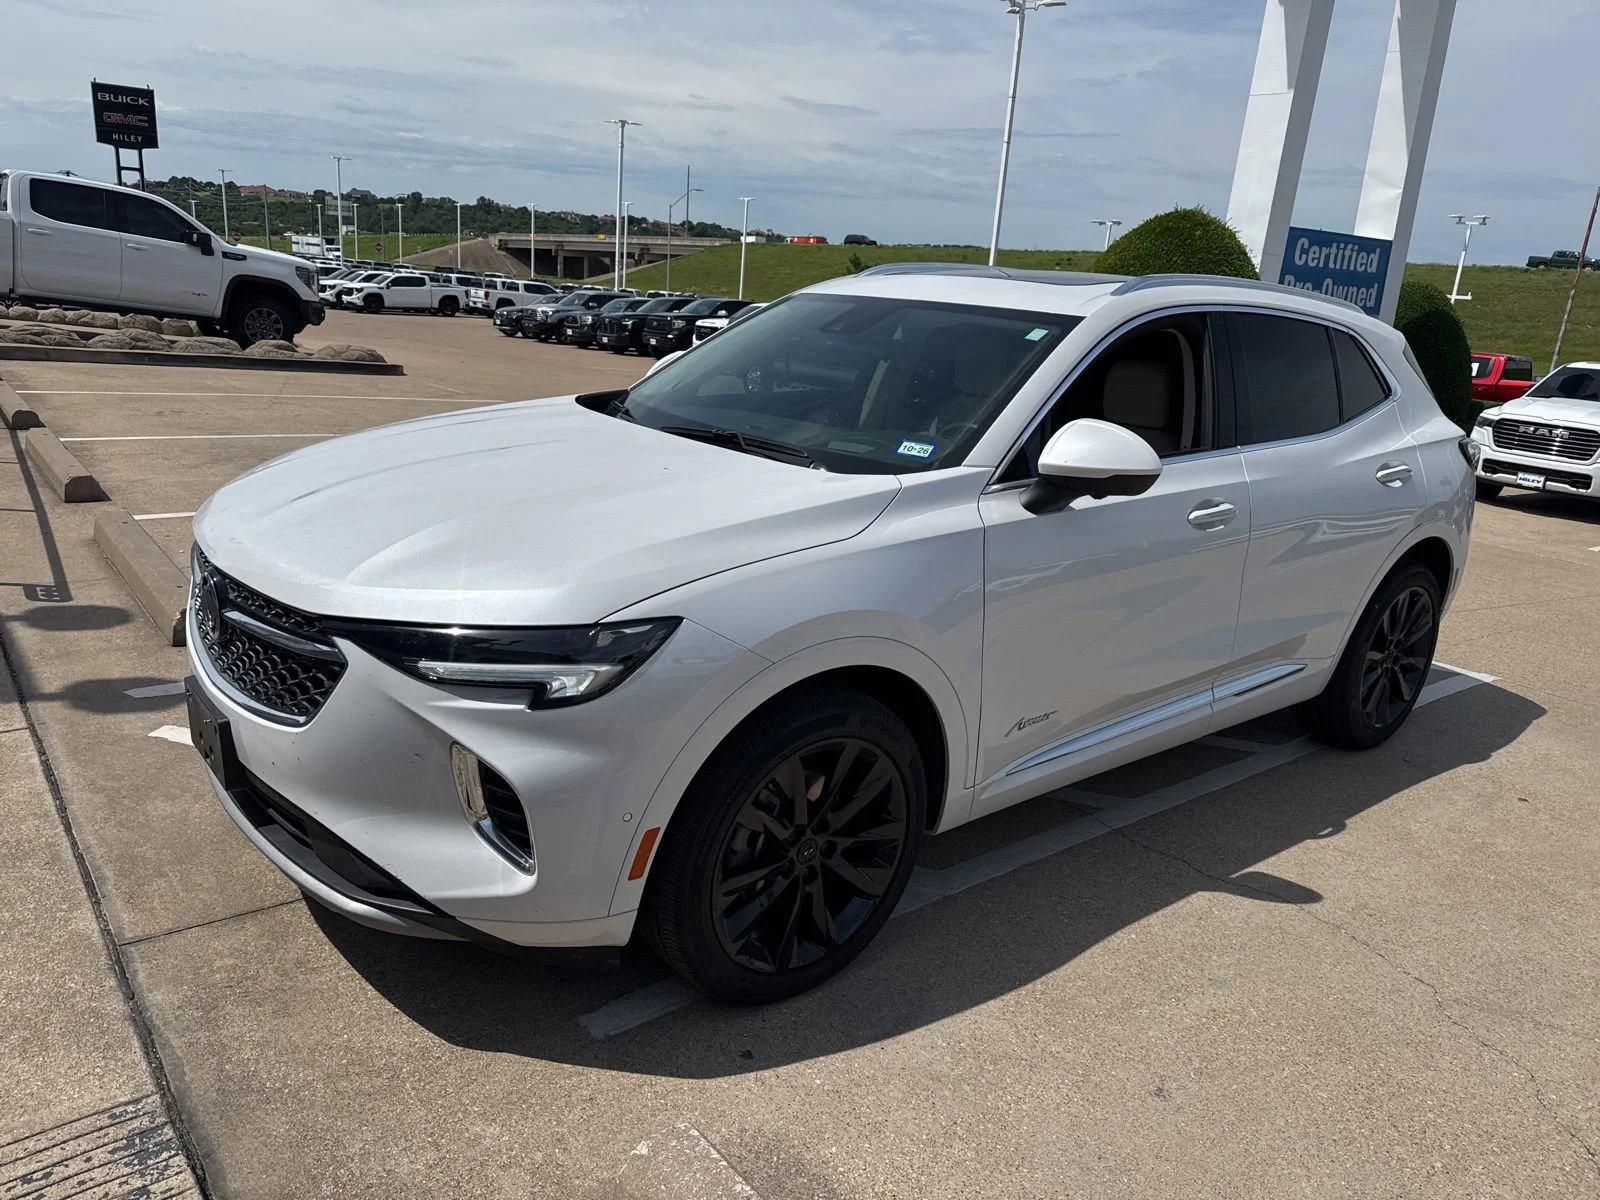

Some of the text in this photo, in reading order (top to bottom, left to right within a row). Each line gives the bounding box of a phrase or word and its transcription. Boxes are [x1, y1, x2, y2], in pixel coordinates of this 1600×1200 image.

[97, 92, 149, 106] BUICK
[103, 112, 149, 127] GMC
[112, 133, 143, 143] HILEY
[1294, 237, 1381, 273] Certified
[1518, 425, 1570, 439] RAM
